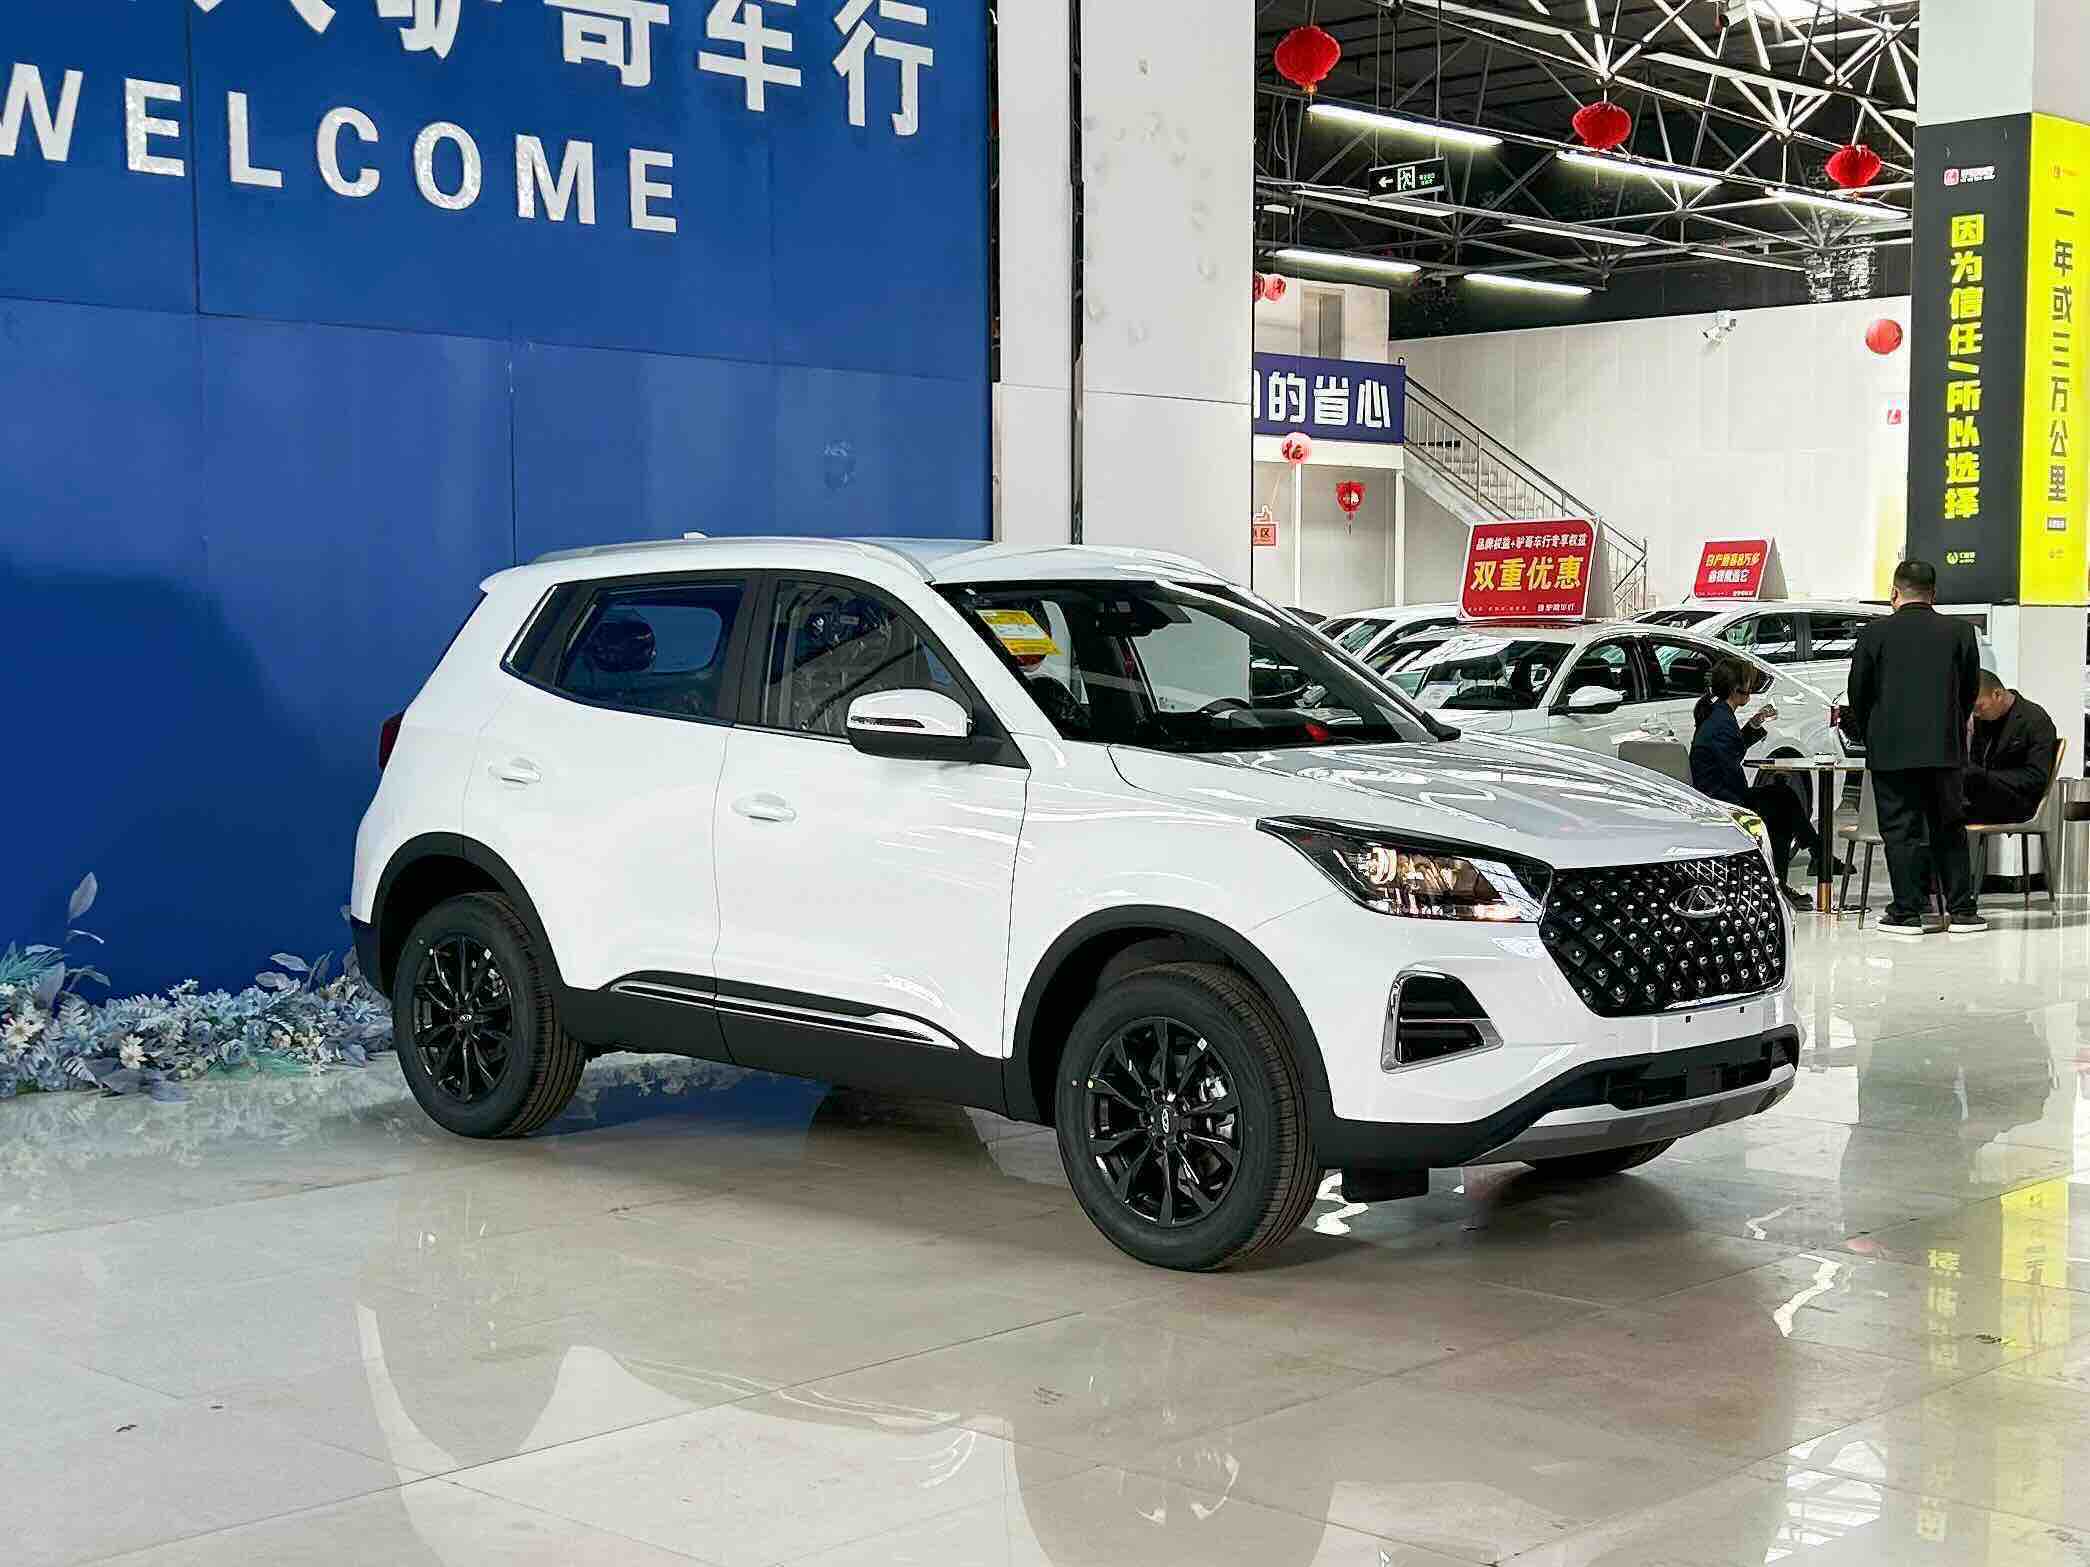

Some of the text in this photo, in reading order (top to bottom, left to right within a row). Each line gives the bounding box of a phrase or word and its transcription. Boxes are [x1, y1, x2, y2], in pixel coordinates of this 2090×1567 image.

[0, 62, 678, 234] WELCOME
[1470, 555, 1584, 592] 双重优惠
